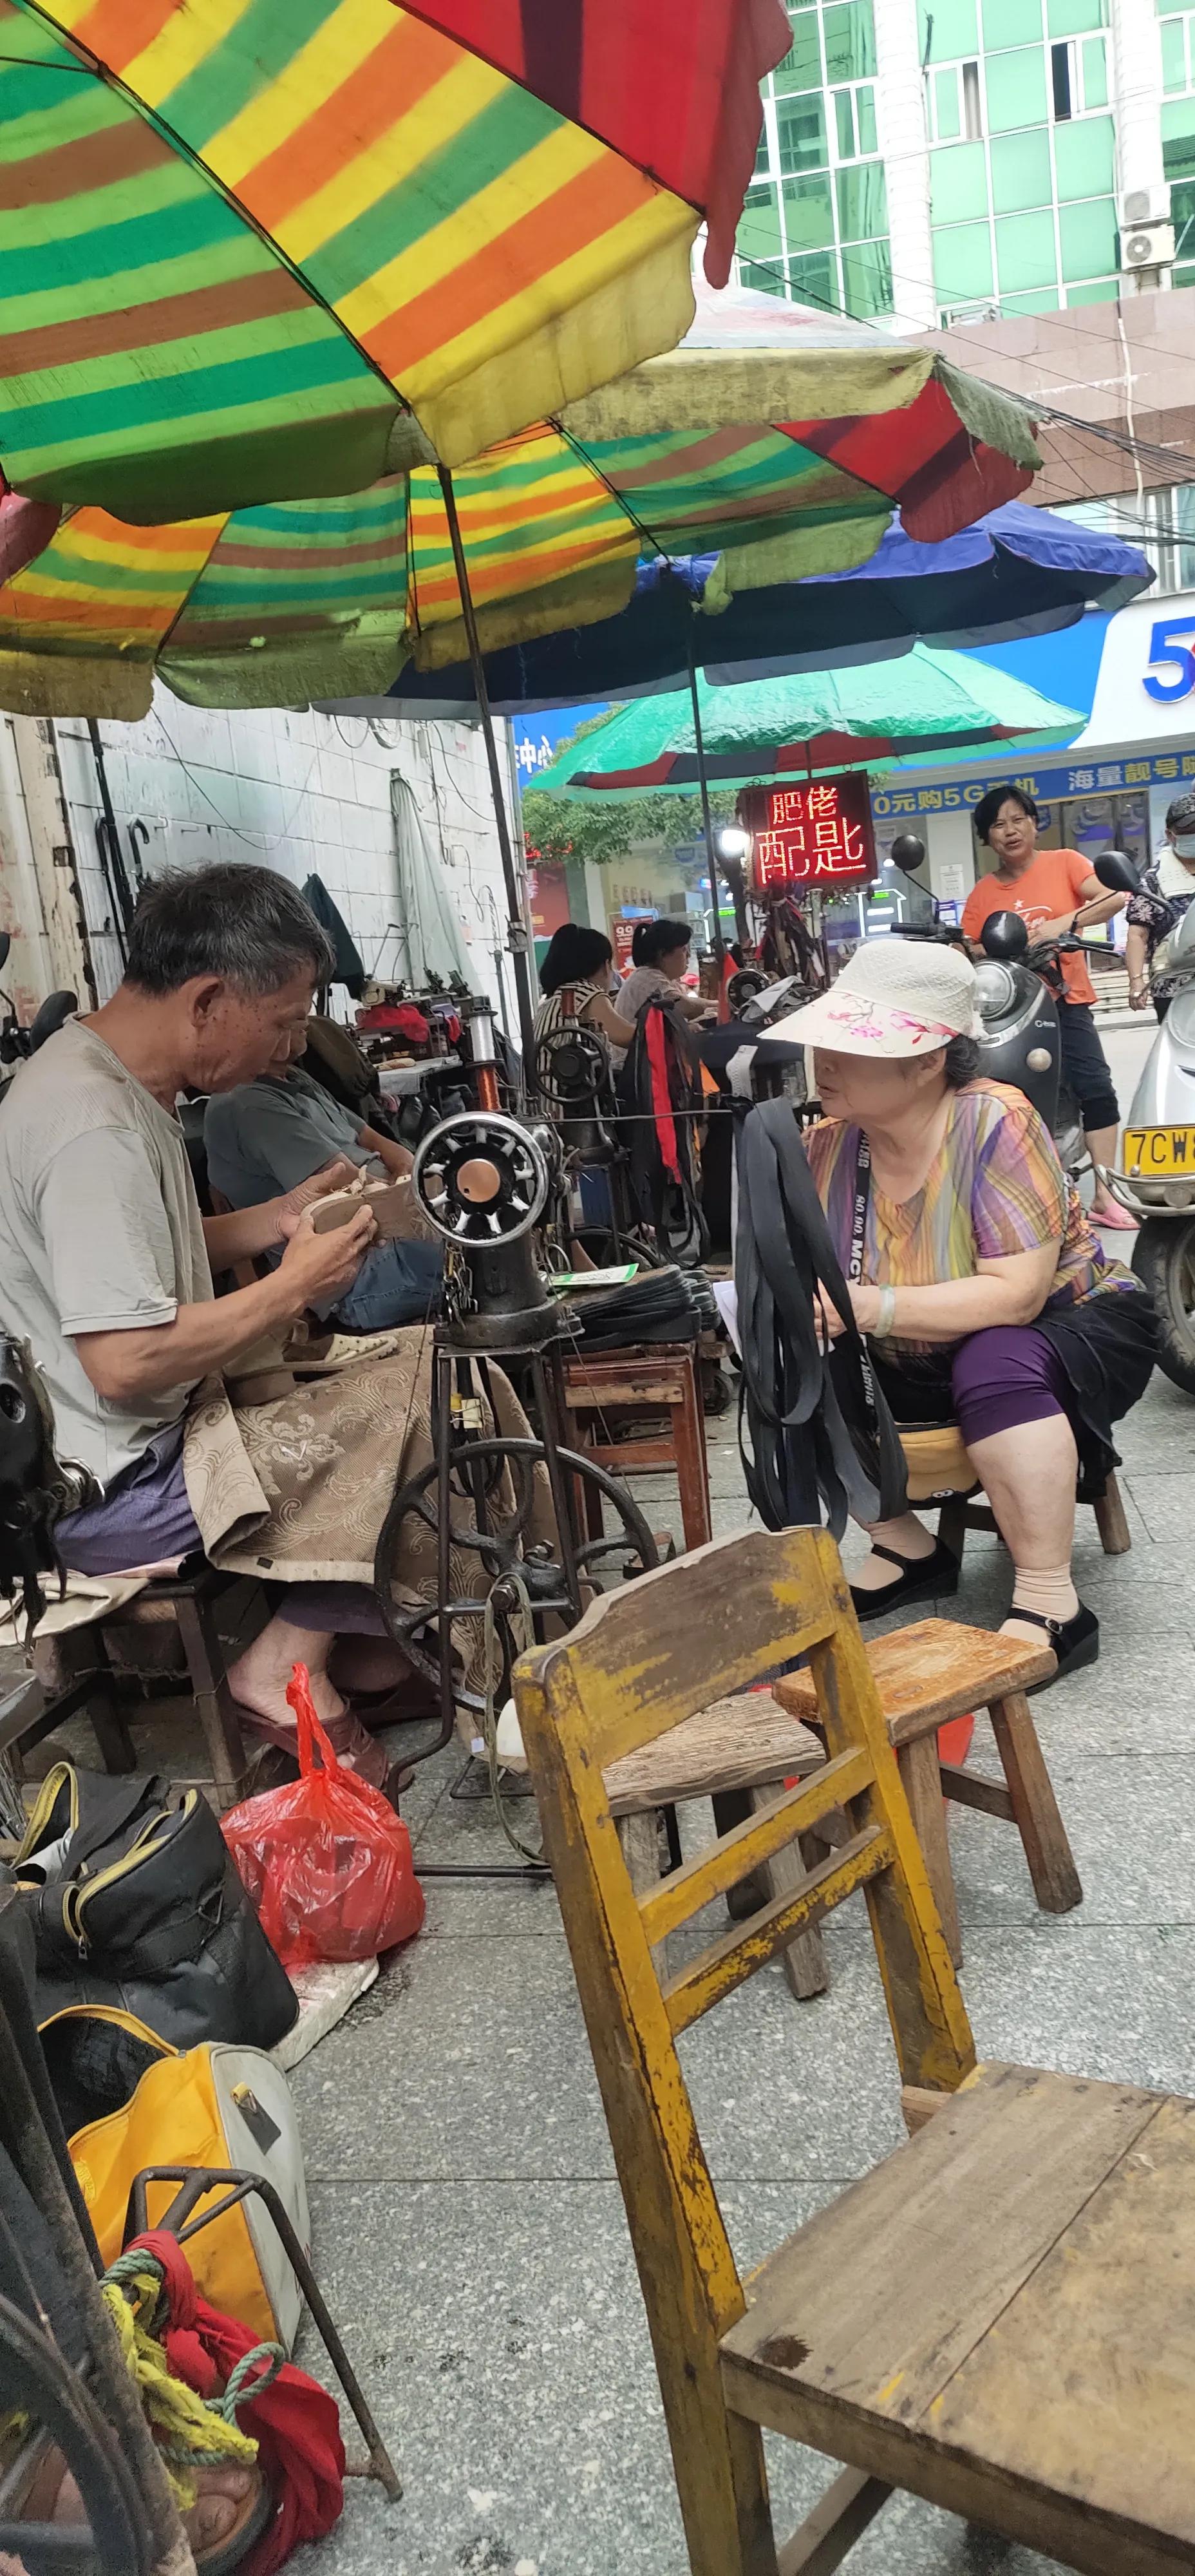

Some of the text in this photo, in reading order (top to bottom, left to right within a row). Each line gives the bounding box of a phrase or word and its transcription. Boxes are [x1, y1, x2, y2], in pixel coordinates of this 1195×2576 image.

[515, 735, 554, 773] 中心
[773, 786, 838, 824] 肥佬
[756, 817, 867, 884] 配匙
[1131, 1132, 1195, 1164] 7CW
